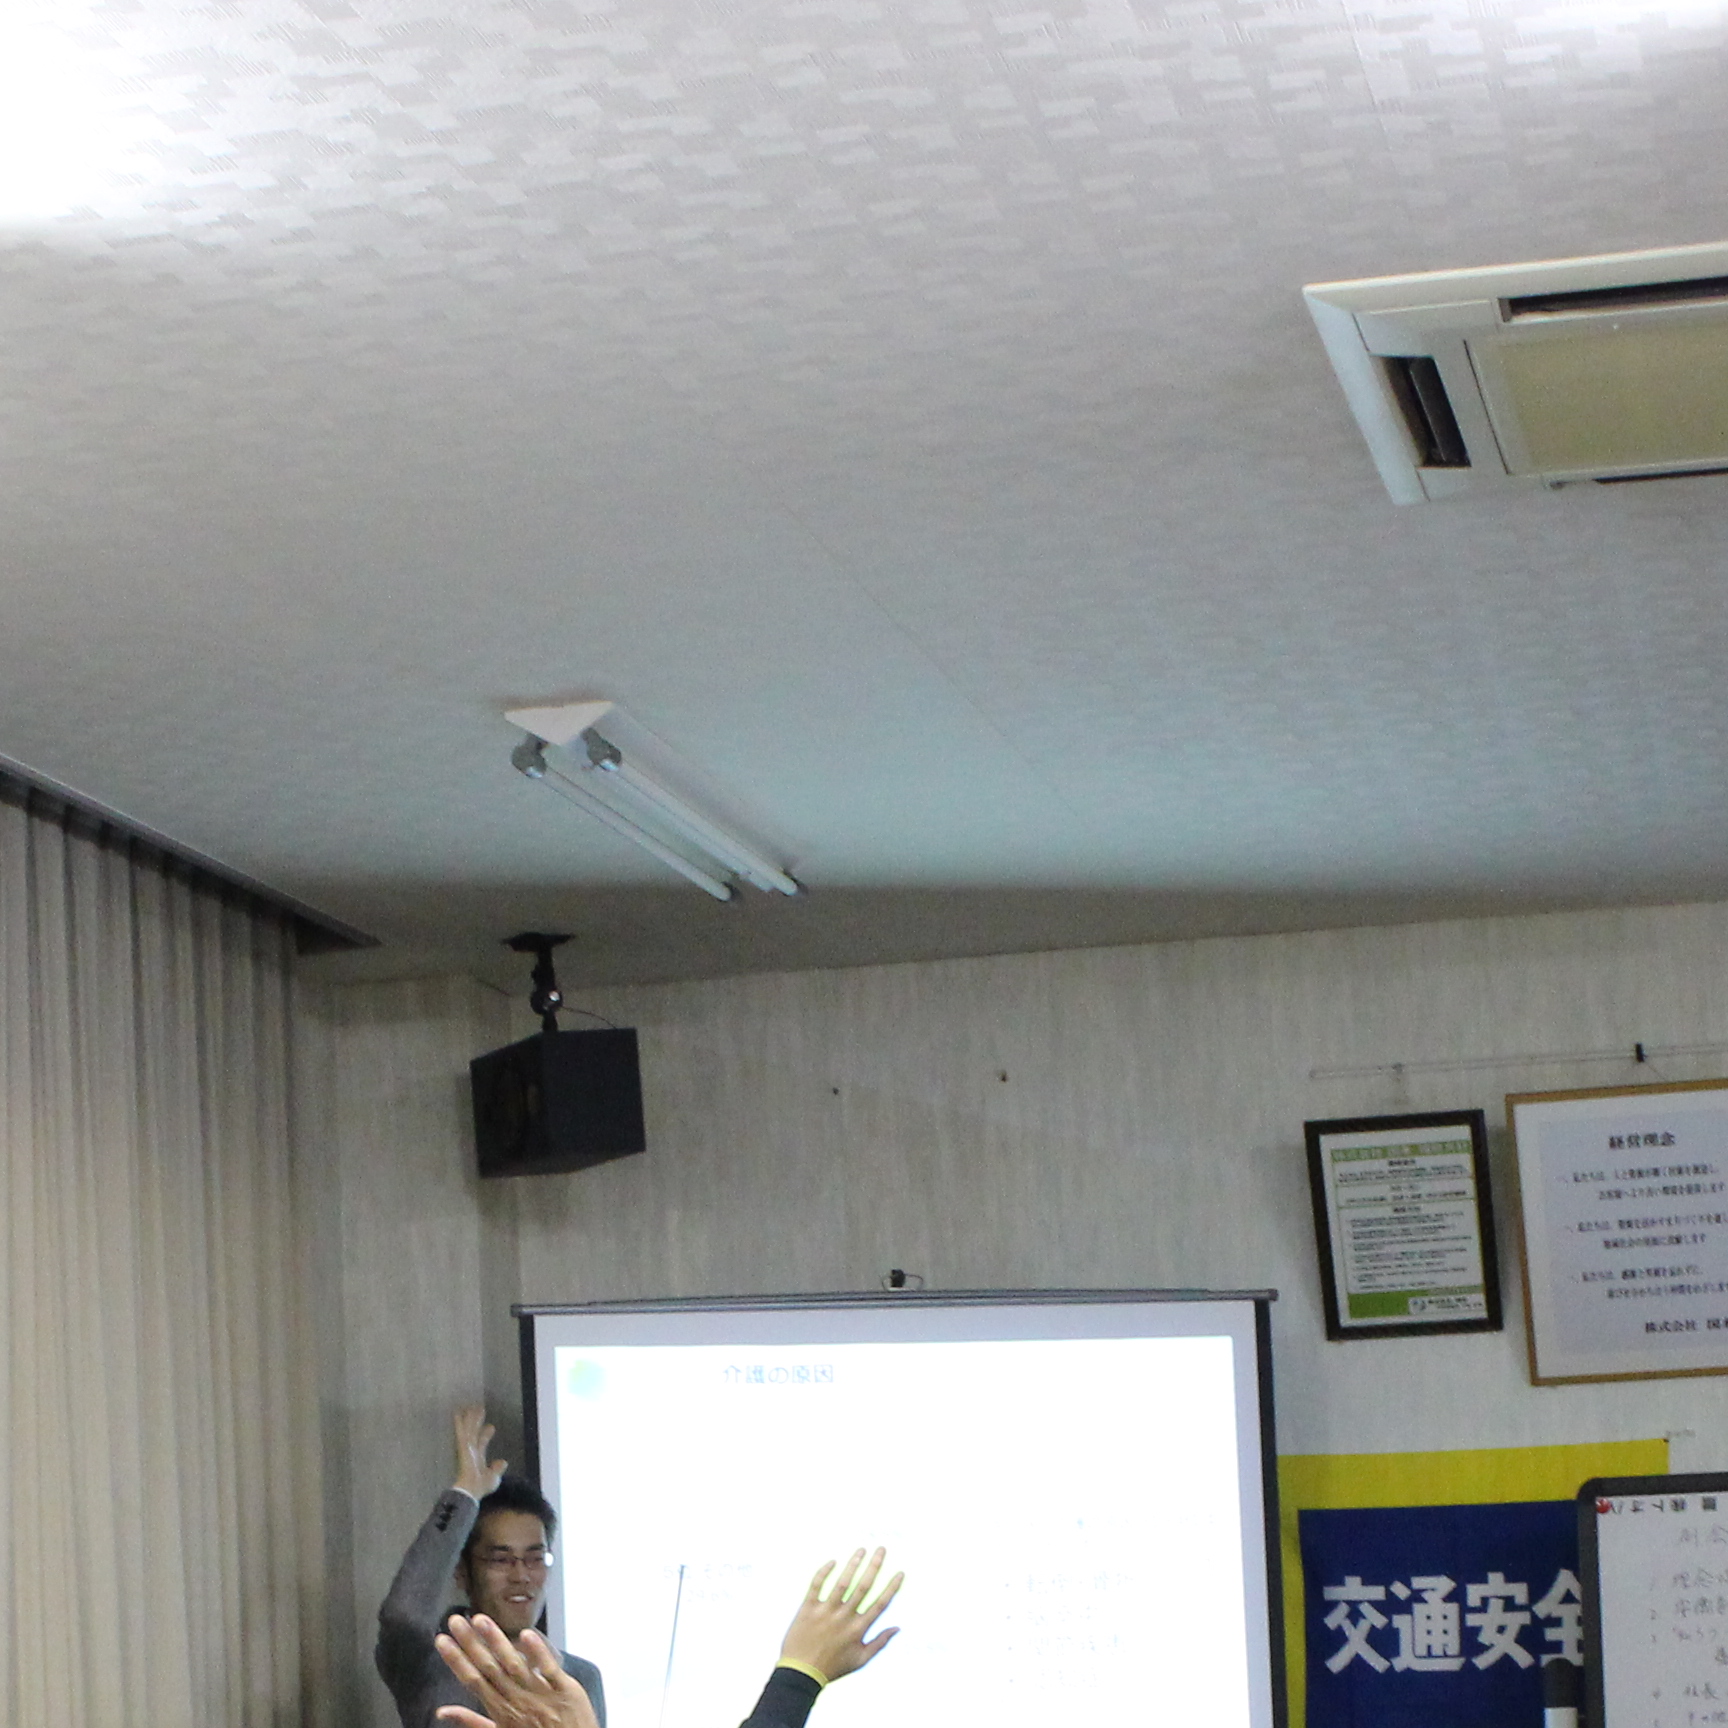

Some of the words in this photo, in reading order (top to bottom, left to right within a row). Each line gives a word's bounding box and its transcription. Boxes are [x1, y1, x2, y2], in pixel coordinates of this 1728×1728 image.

[1609, 1132, 1675, 1151] 経営理念
[723, 1363, 834, 1384] 介護の原因
[1323, 1568, 1584, 1675] 交通安全
